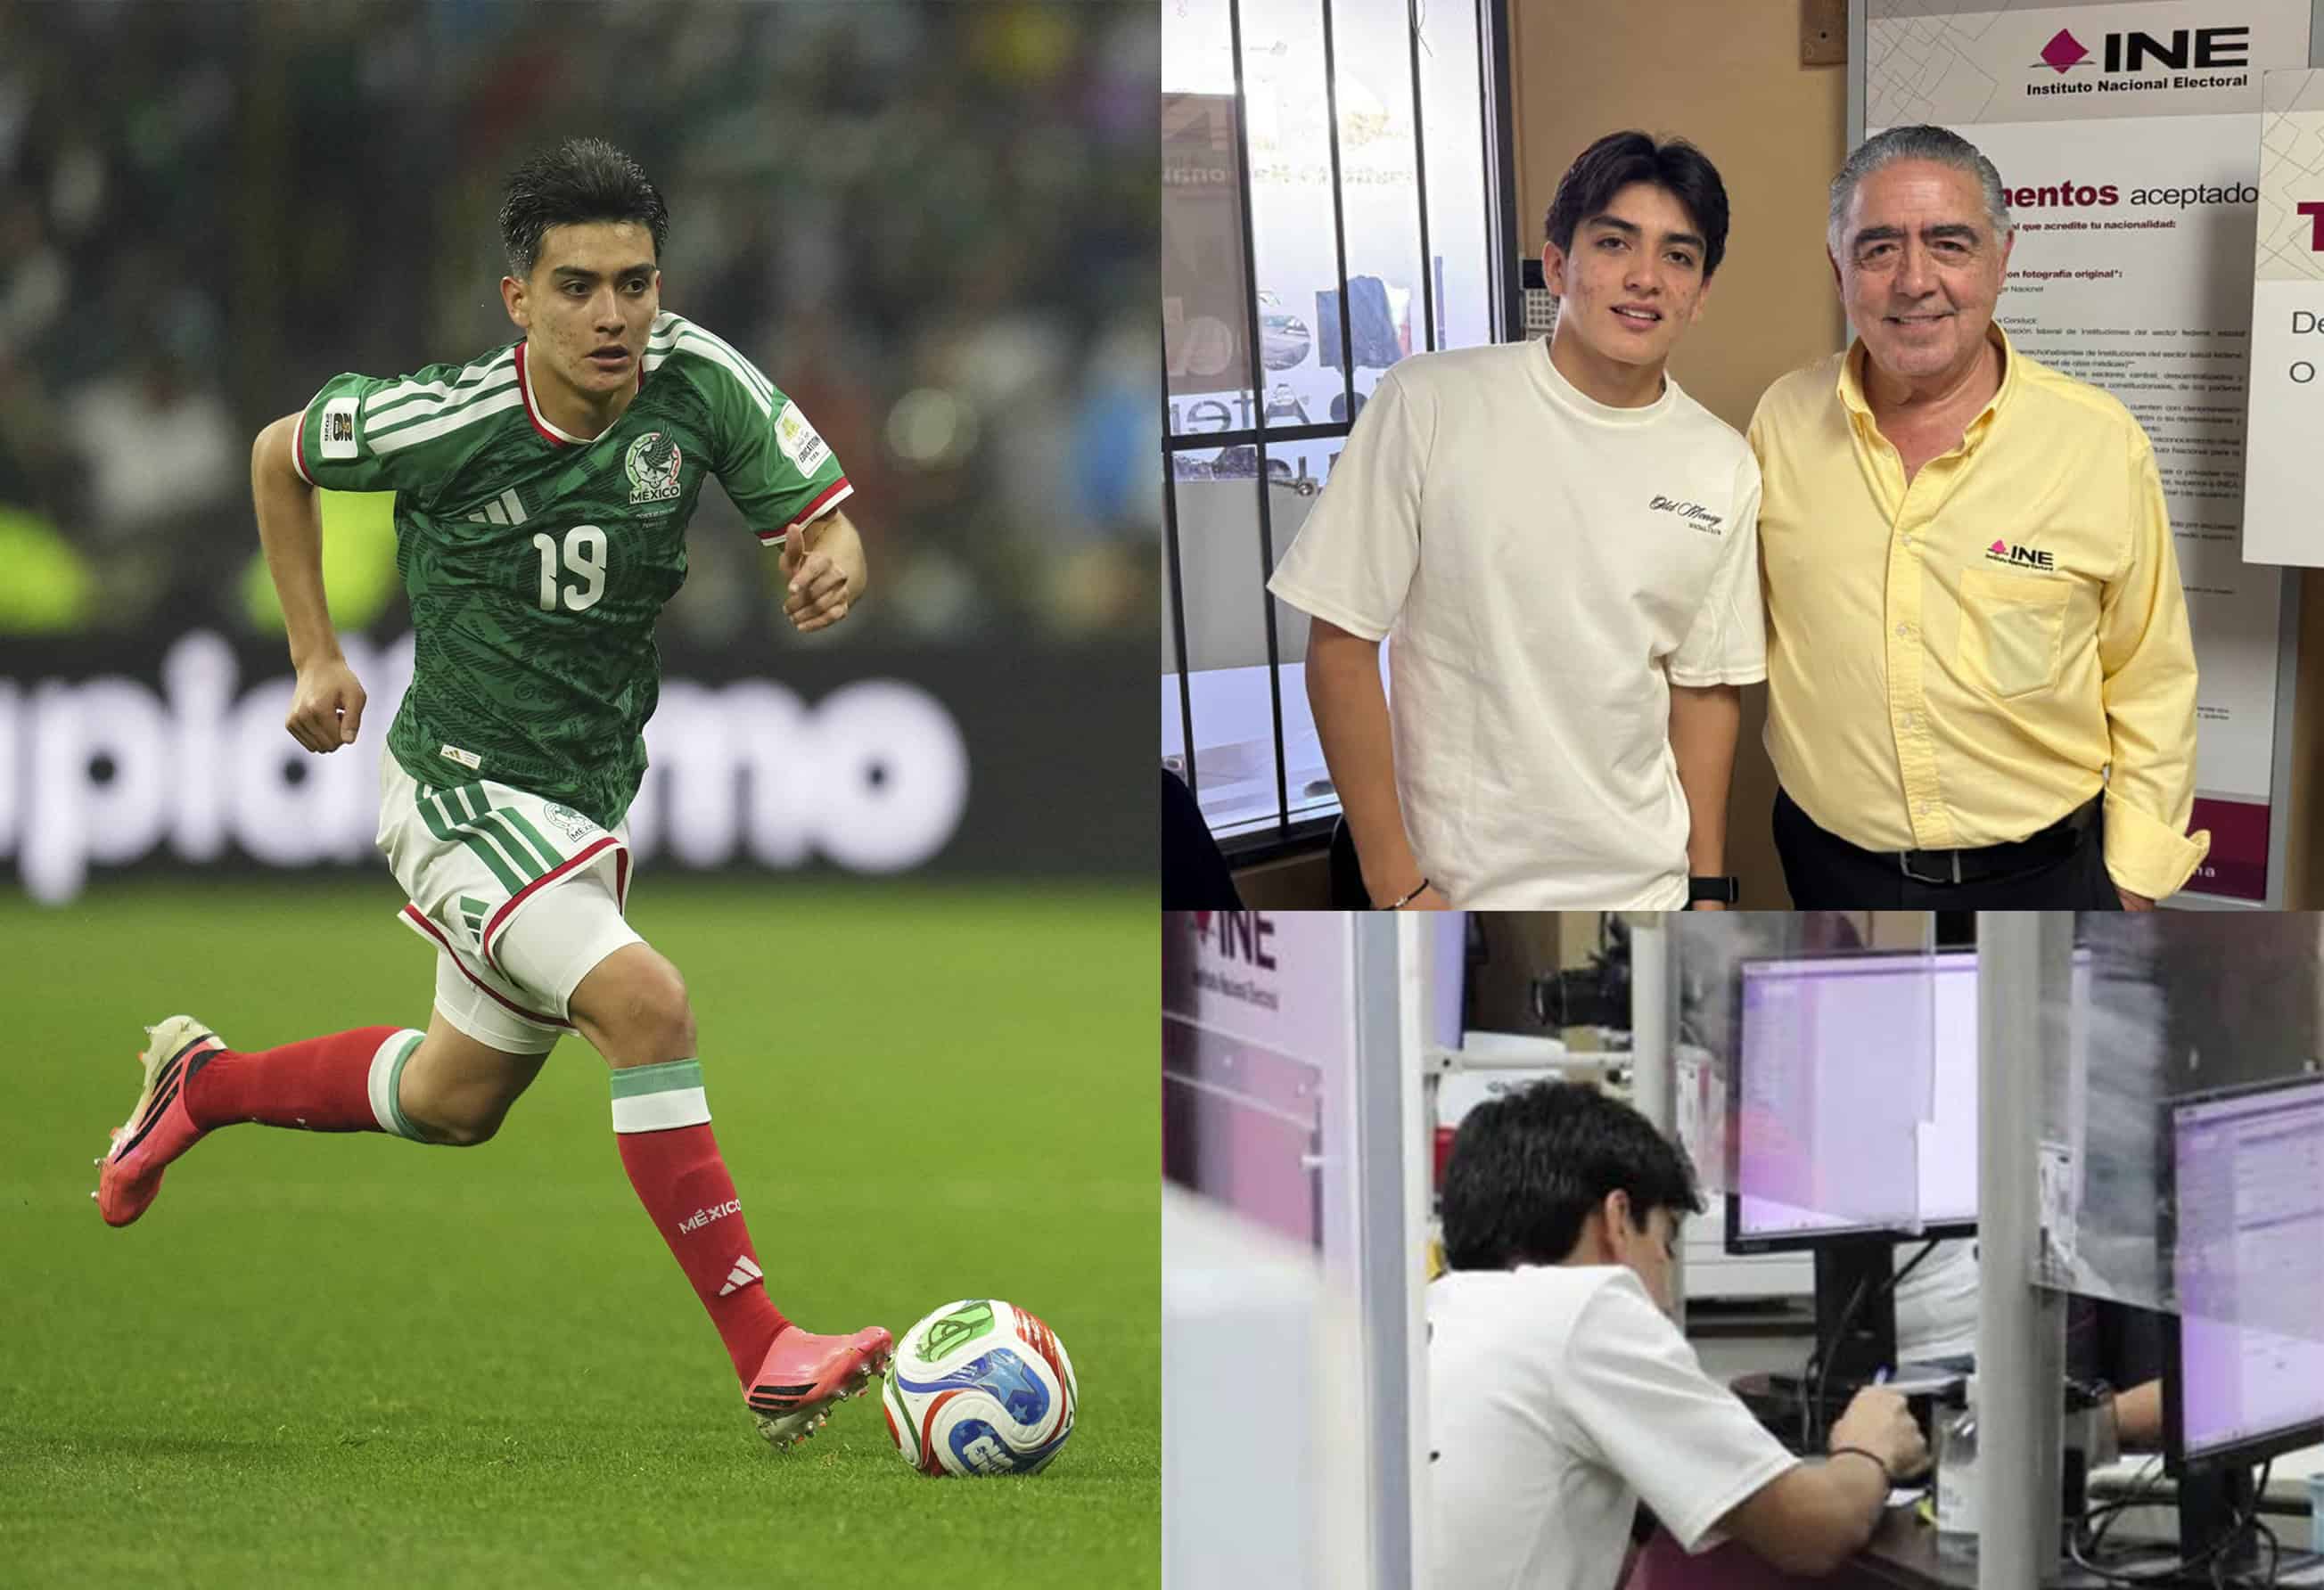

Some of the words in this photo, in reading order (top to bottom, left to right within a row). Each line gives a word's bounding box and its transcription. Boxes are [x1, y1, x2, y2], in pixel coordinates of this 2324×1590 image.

[2104, 27, 2249, 73] INE
[2026, 83, 2093, 96] Instituto
[2098, 78, 2168, 92] Nacional
[2172, 74, 2248, 88] Electoral
[2130, 181, 2259, 209] aceptado
[533, 524, 607, 611] 19
[2010, 545, 2054, 566] INE
[1218, 910, 1277, 971] INE
